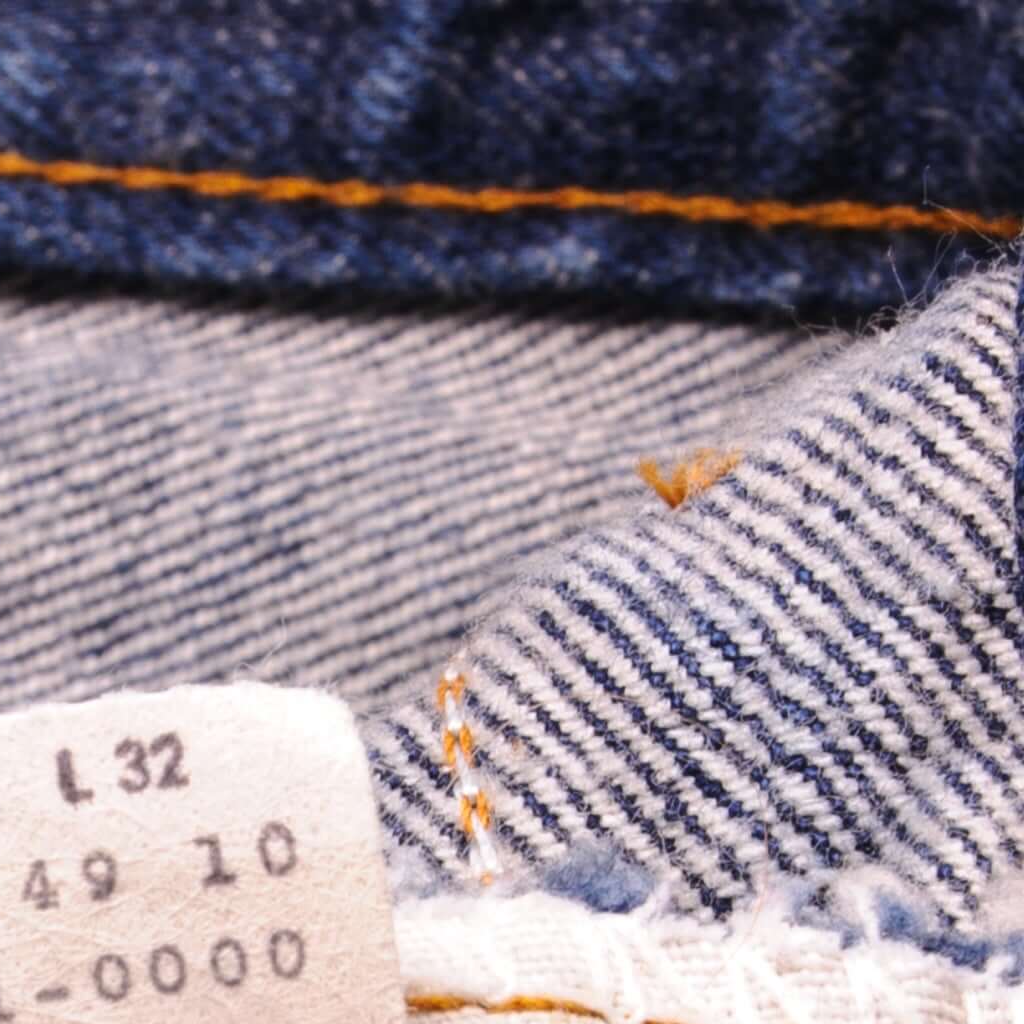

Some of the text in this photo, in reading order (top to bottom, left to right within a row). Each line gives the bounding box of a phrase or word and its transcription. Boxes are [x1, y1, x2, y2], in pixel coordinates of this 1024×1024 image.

[56, 748, 94, 806] L
[114, 732, 190, 794] 32
[22, 850, 118, 911] 49
[193, 821, 298, 888] 10
